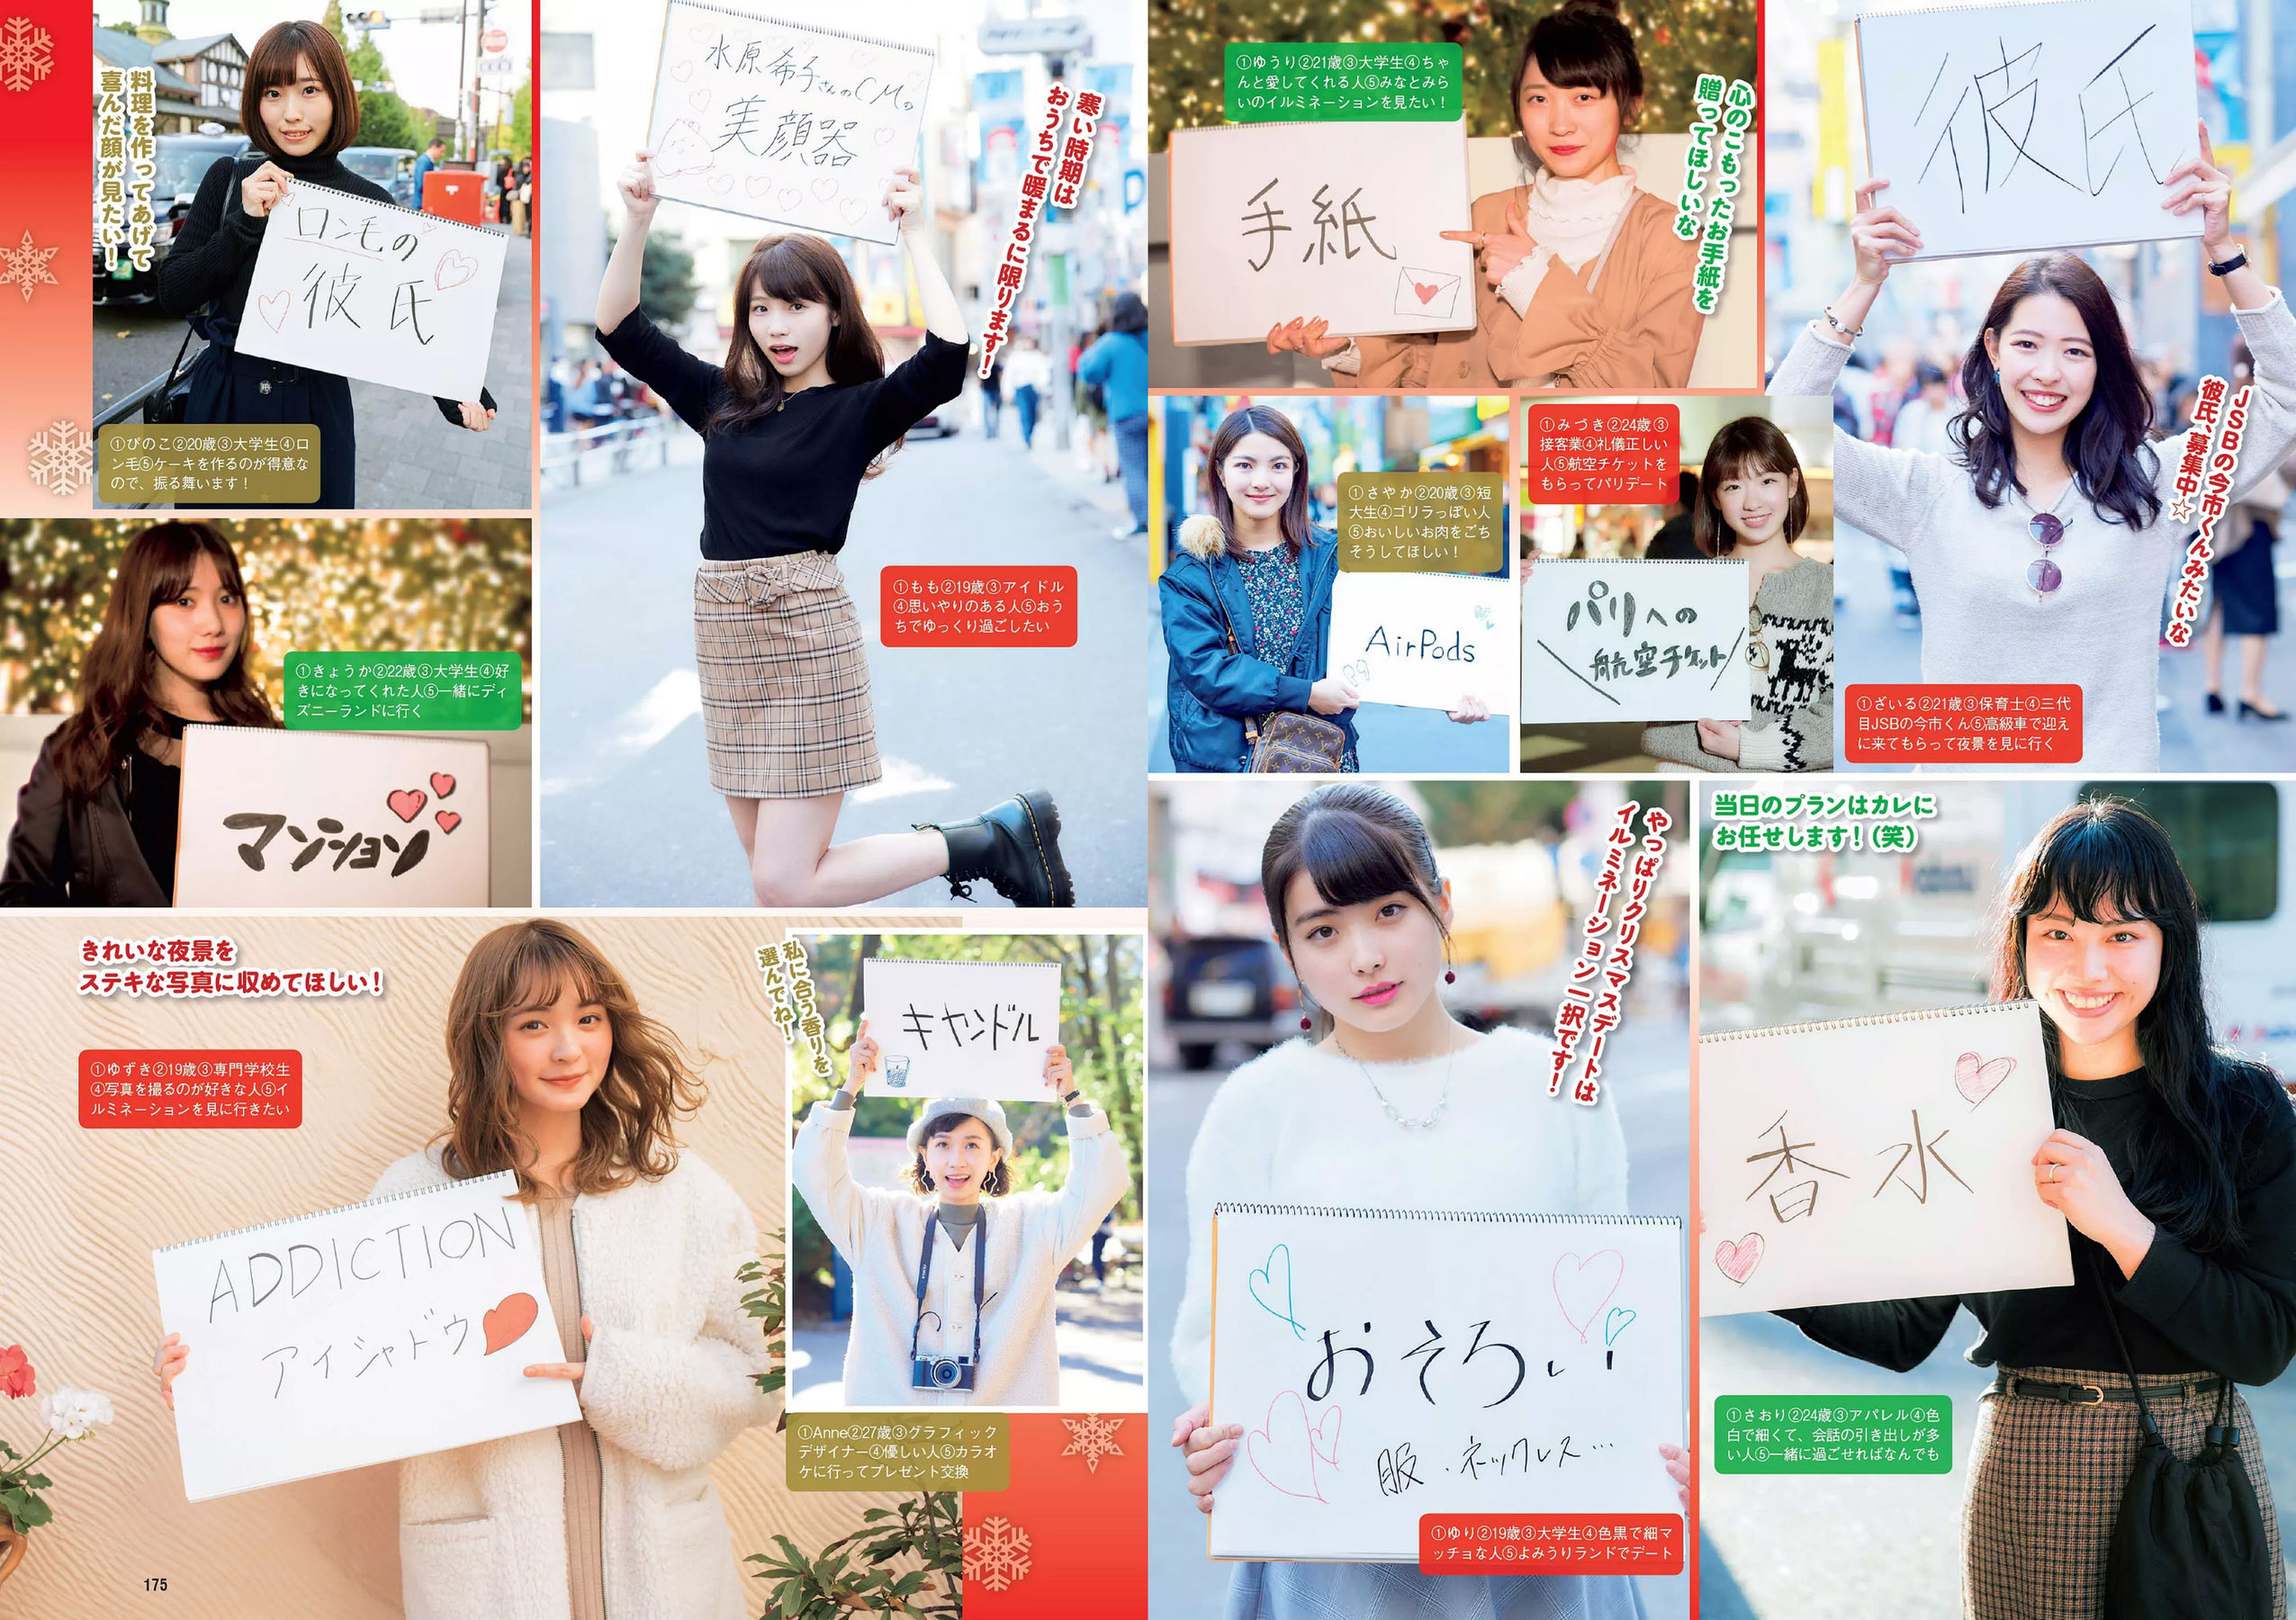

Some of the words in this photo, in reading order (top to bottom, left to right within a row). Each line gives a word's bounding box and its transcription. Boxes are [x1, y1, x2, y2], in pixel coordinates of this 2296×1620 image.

[710, 94, 858, 166] 美顔器
[1913, 23, 2187, 214] 彼氏
[298, 207, 419, 262] ロン毛の
[1240, 177, 1398, 273] 手紙
[302, 262, 435, 346] 彼氏
[1365, 626, 1476, 664] AirPods
[1567, 580, 1697, 637] パリへの
[1589, 641, 1726, 682] 航空チケット
[222, 813, 430, 878] マンション
[1747, 1109, 1974, 1223] 香水
[210, 1206, 517, 1324] ADDICTION
[262, 1308, 468, 1399] アイシャドウ
[1307, 1319, 1614, 1408] おそろい
[143, 1578, 168, 1592] 175
